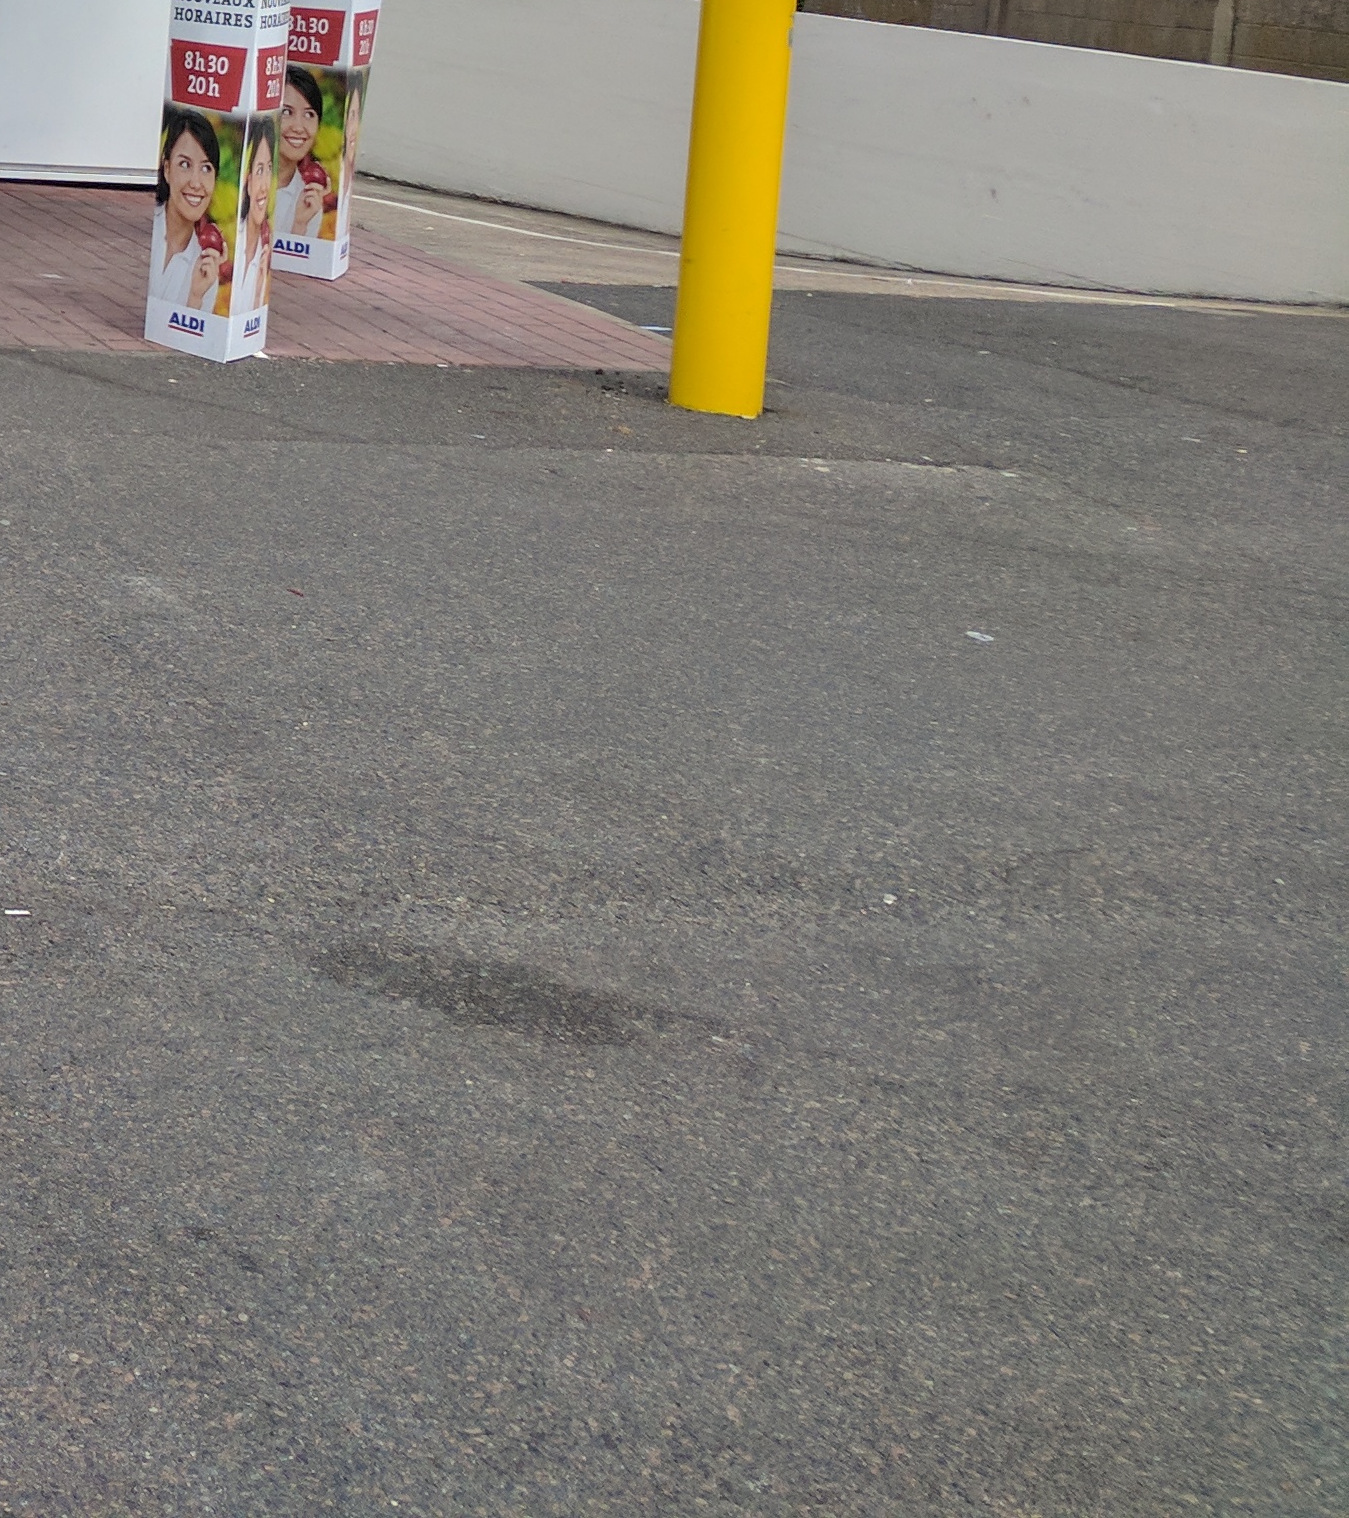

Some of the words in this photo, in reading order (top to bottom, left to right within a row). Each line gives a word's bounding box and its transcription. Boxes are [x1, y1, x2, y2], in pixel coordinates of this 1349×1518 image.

[174, 6, 254, 28] HORAIRES
[273, 238, 310, 255] ALDI
[169, 311, 205, 333] ALDI
[244, 315, 261, 333] ALDI
